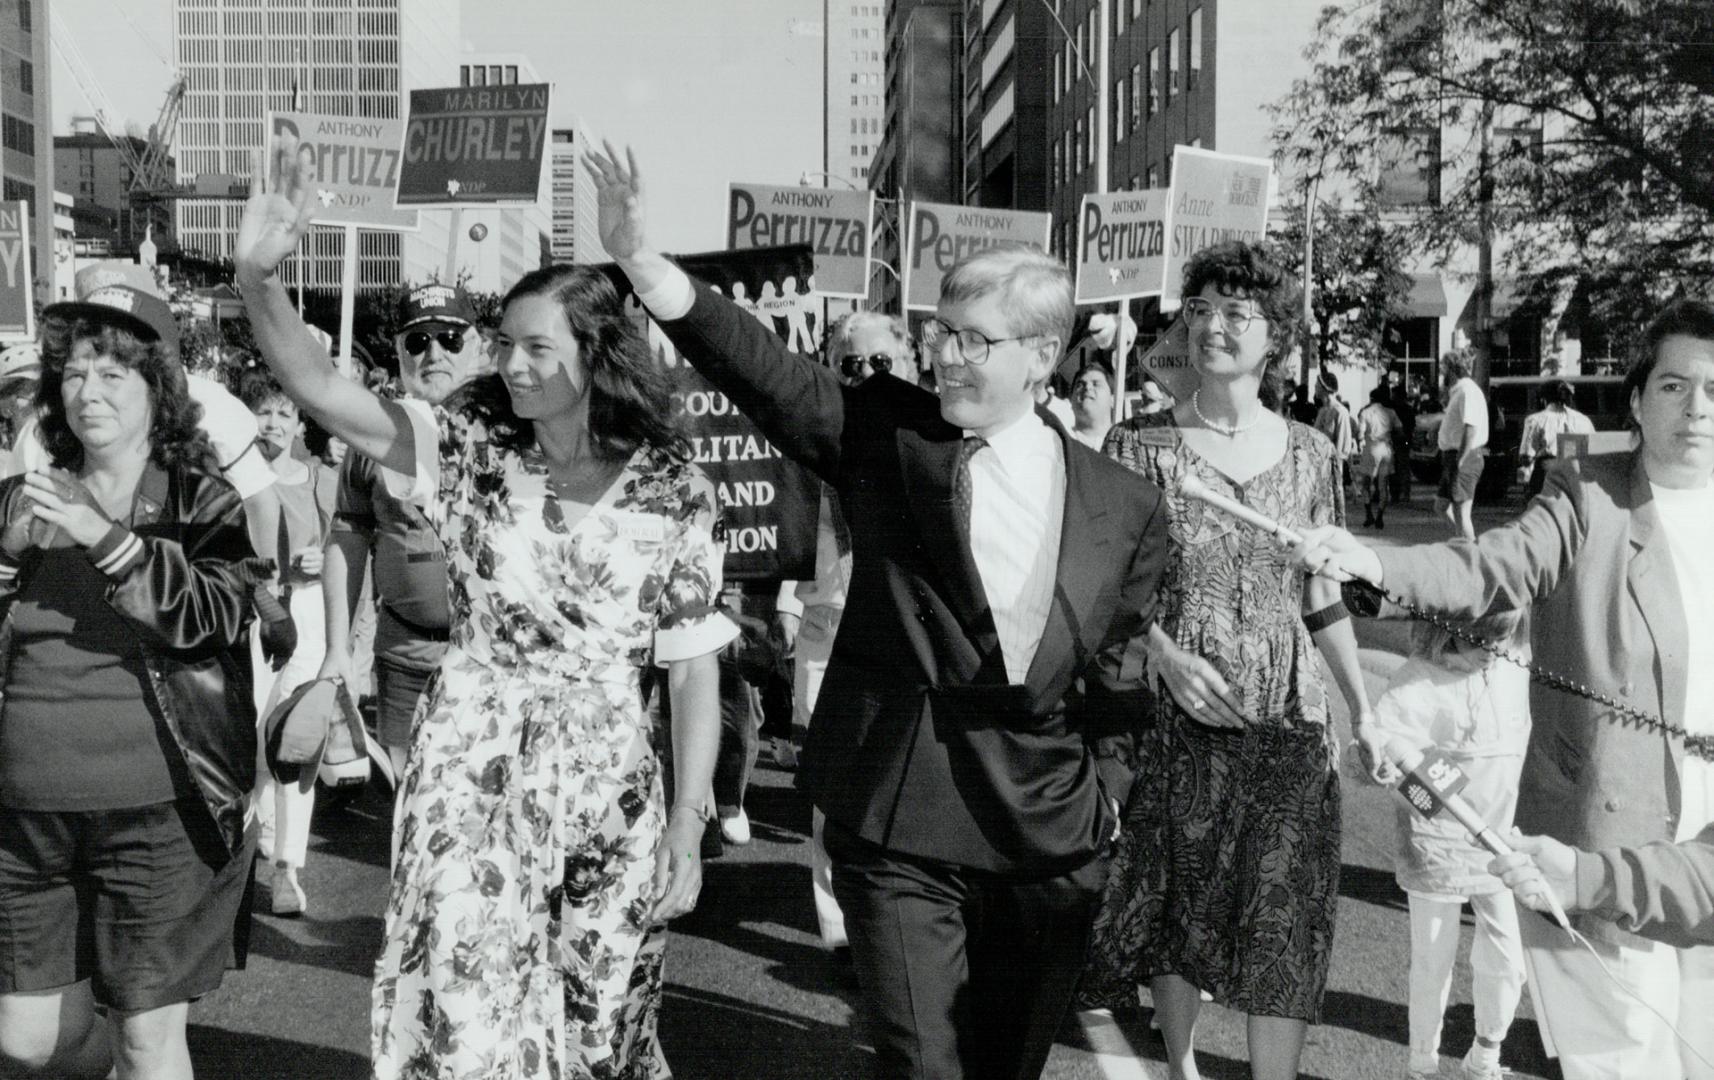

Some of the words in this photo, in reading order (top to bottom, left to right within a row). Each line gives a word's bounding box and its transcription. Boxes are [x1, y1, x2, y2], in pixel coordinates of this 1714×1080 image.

[444, 89, 546, 110] MARILYN
[316, 121, 383, 139] ANTHONY
[405, 117, 546, 163] CHURLEY
[772, 191, 833, 208] ANTHONY
[1111, 199, 1148, 214] ANTHONY
[1176, 191, 1214, 216] Anne
[956, 214, 1014, 231] ANTHONY
[1082, 202, 1164, 264] Perruzza
[913, 209, 1042, 272] Perr
[764, 300, 795, 310] REGION
[718, 480, 775, 507] AND
[724, 525, 778, 554] ION
